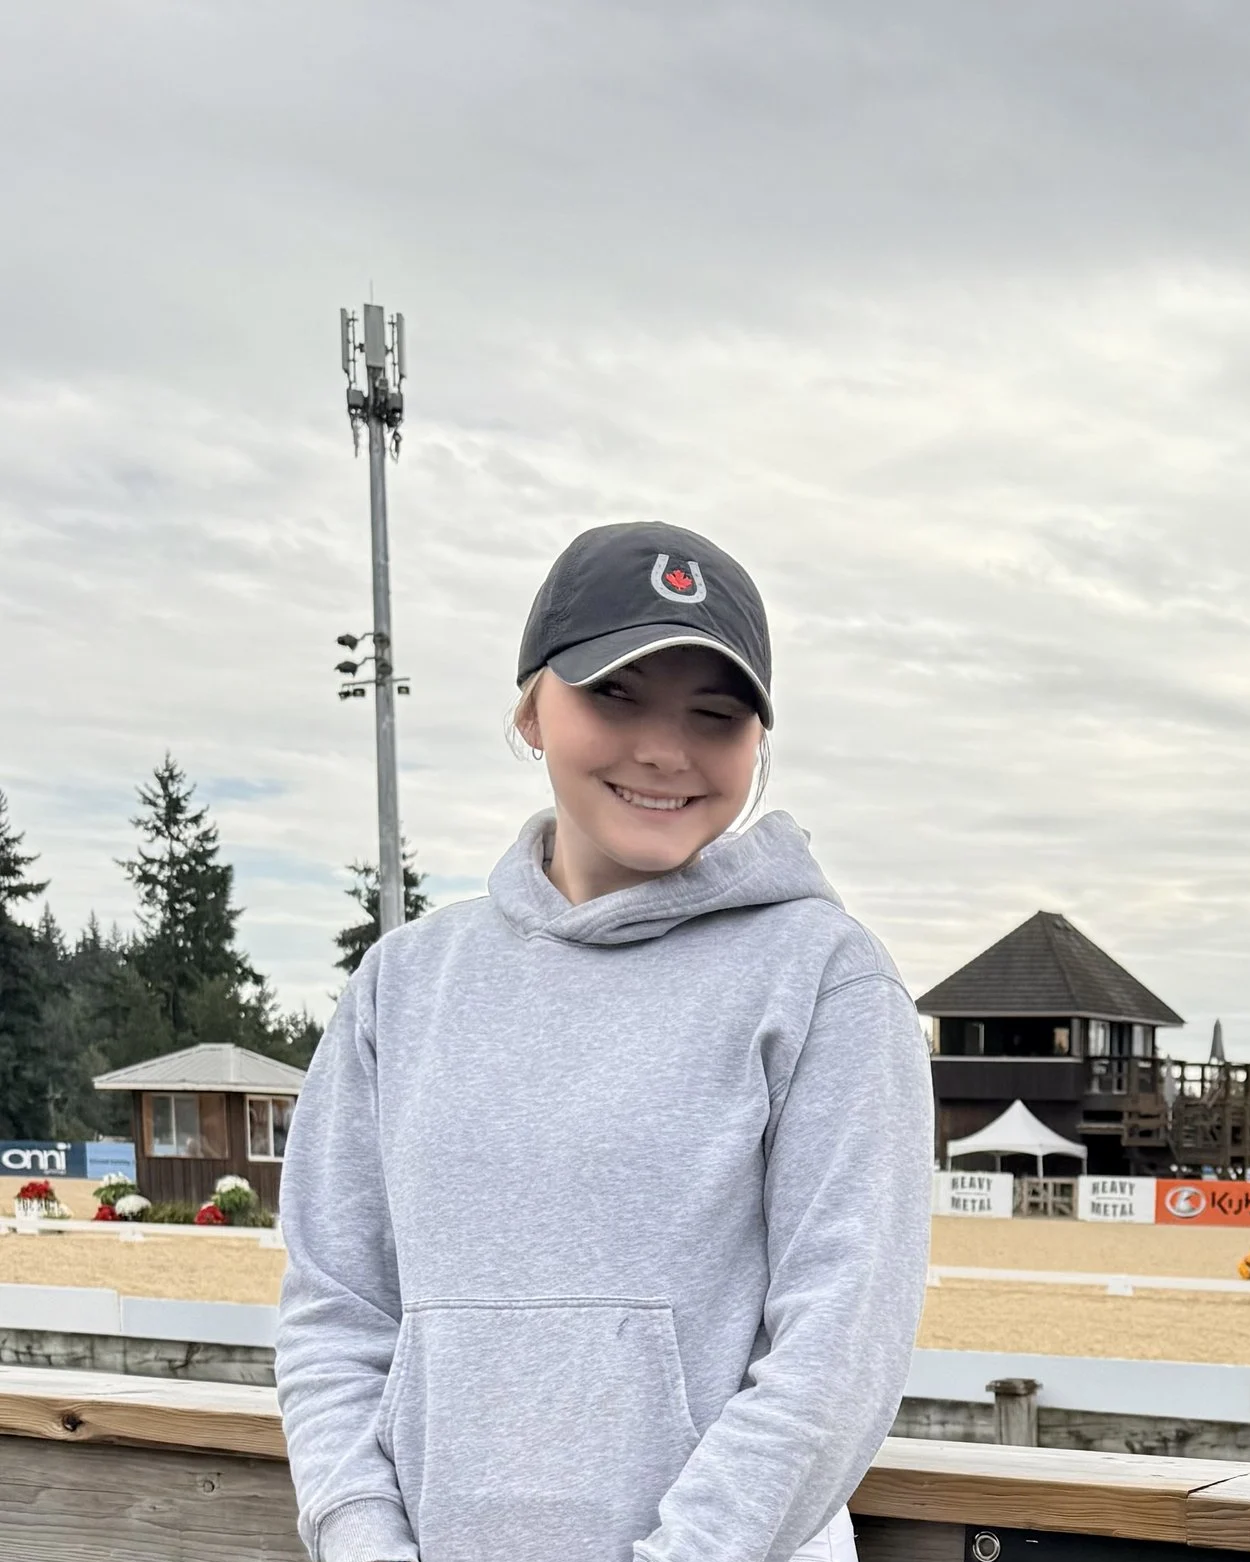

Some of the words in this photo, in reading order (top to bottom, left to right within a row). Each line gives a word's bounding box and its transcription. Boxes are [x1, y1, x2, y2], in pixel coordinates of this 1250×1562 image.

[951, 1176, 992, 1191] HEAVY
[1091, 1181, 1136, 1196] HEAVY
[951, 1197, 992, 1212] METAL
[1091, 1202, 1136, 1217] METAL
